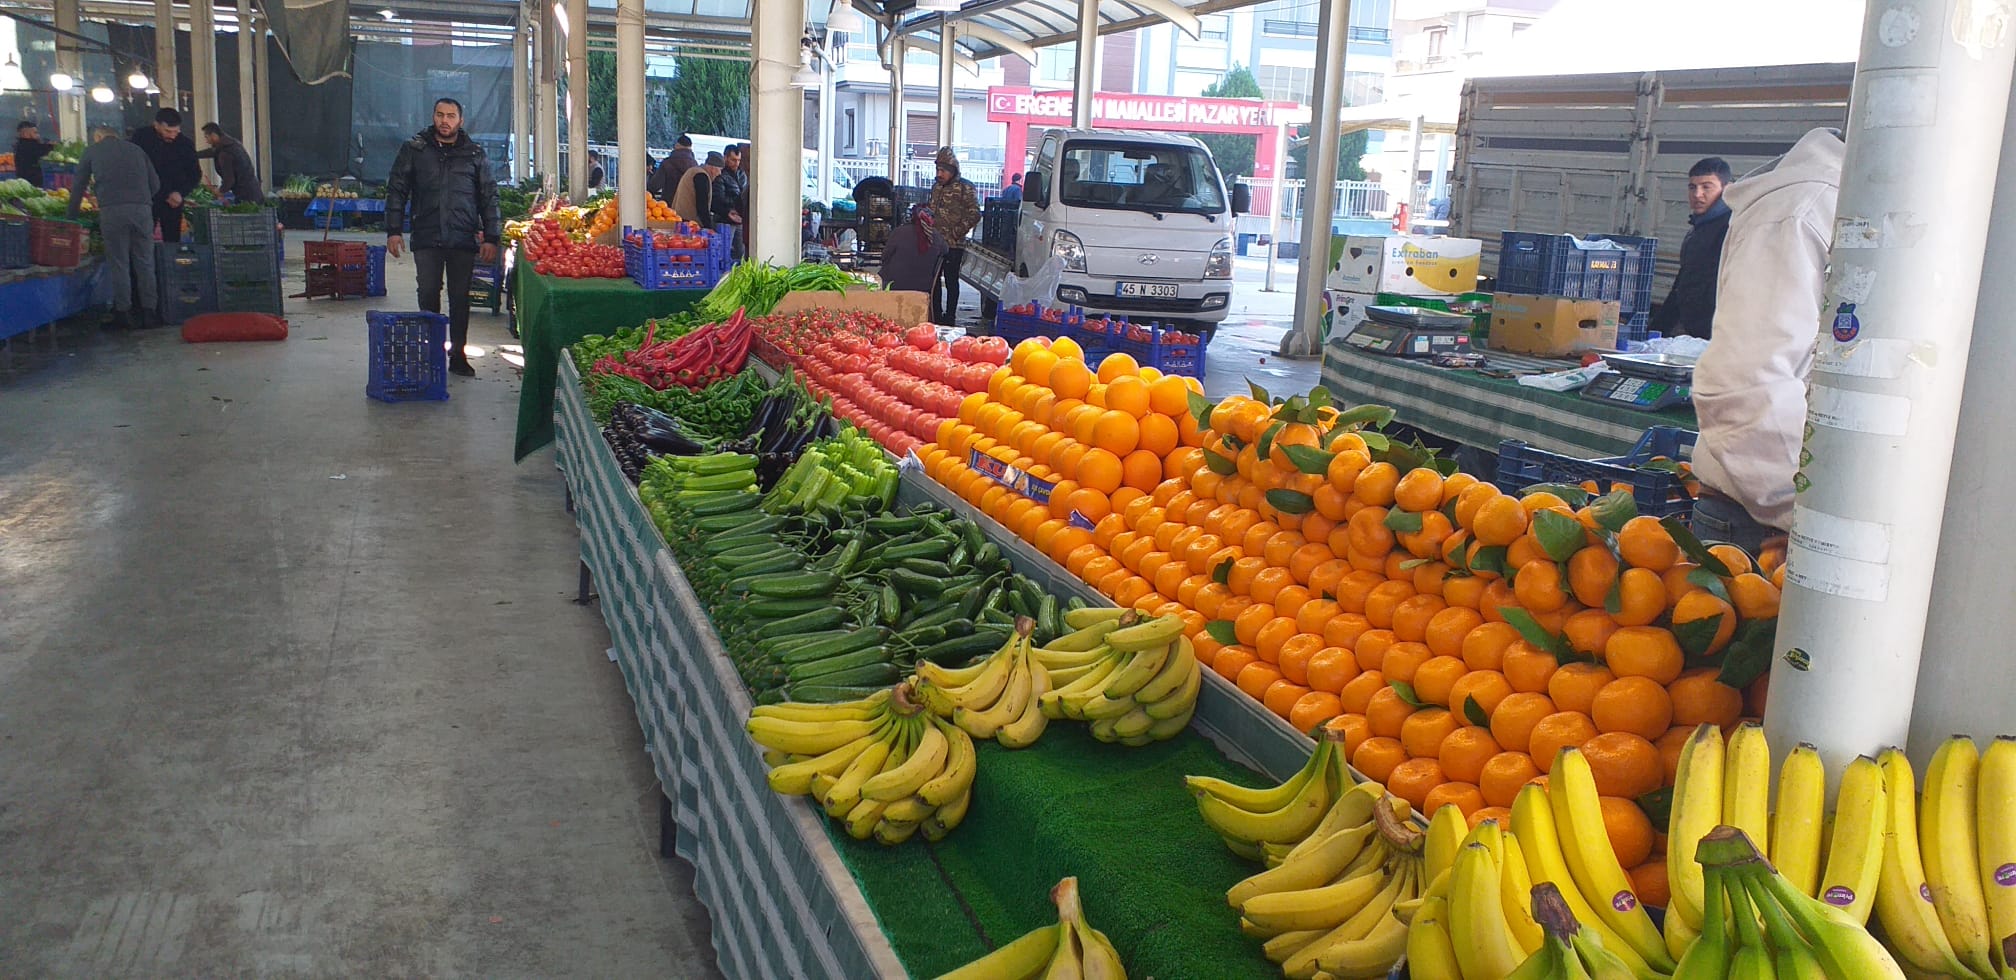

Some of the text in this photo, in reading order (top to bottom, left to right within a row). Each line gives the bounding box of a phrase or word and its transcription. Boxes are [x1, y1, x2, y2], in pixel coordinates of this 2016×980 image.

[1016, 94, 1103, 119] ERGENEN
[1105, 98, 1187, 123] MAHALLESİ
[1392, 247, 1439, 259] Extraban
[1122, 283, 1176, 297] 45 N 3303
